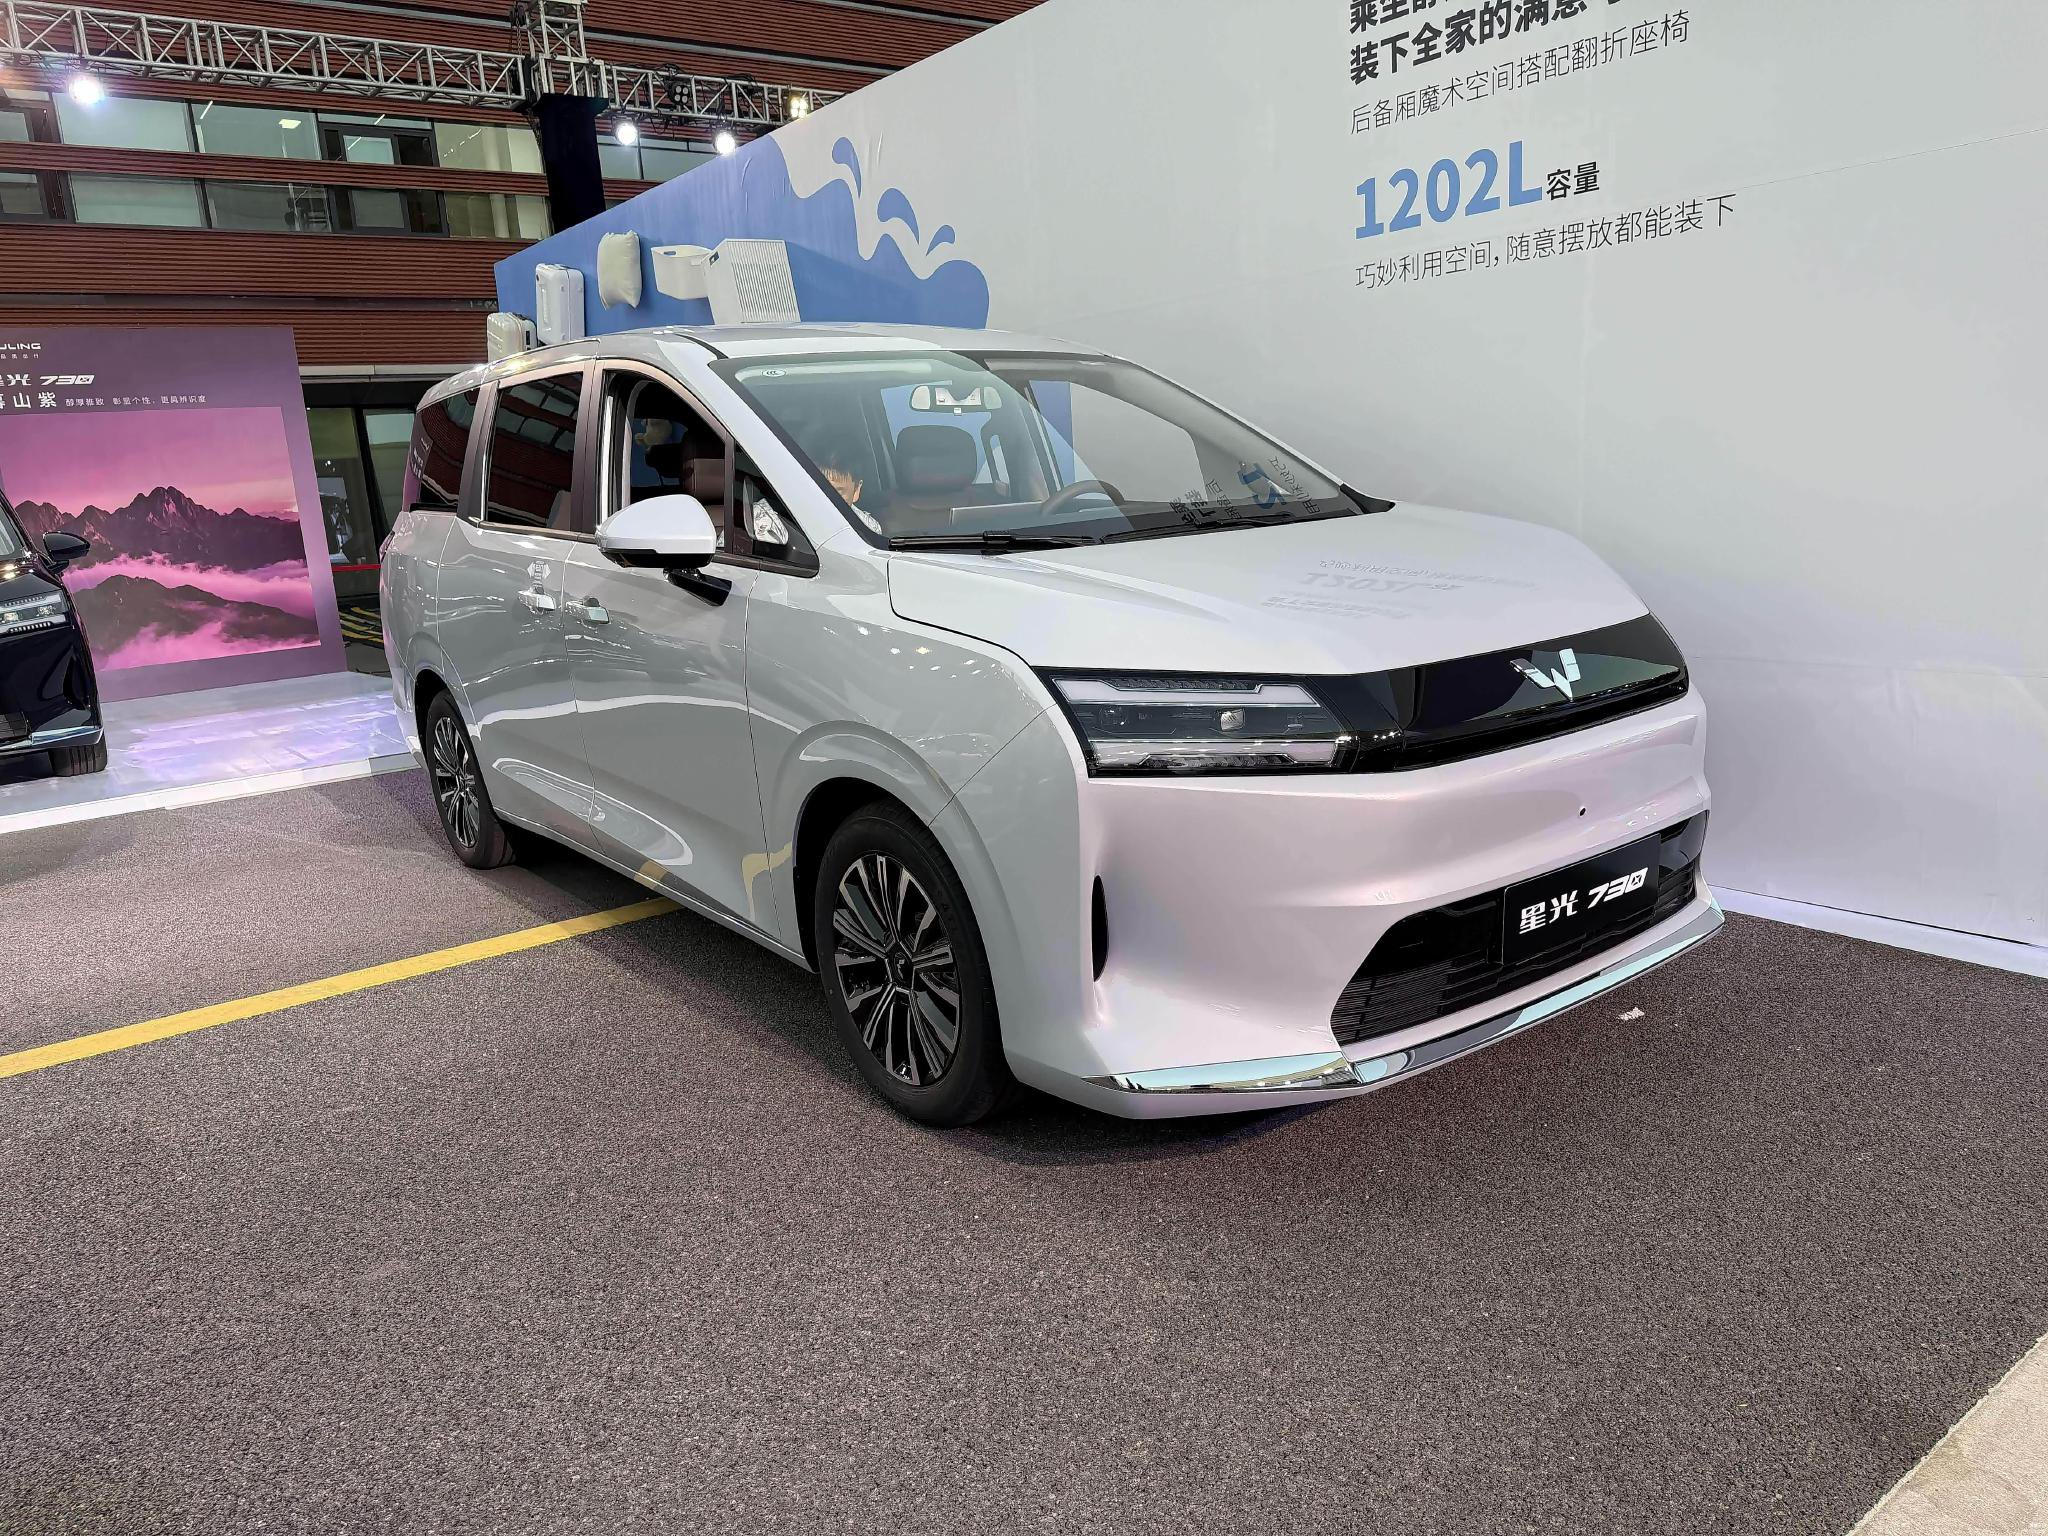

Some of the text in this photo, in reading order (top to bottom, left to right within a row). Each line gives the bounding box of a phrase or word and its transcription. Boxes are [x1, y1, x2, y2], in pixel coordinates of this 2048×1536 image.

[1349, 0, 1624, 85] 装下全家的满
[1350, 9, 1690, 135] 后备厢魔术空间搭配翻折座椅
[1355, 140, 1601, 240] 1202L 容量
[0, 342, 41, 350] ULING
[0, 374, 32, 386] 光
[1518, 867, 1649, 935] 星光 730
